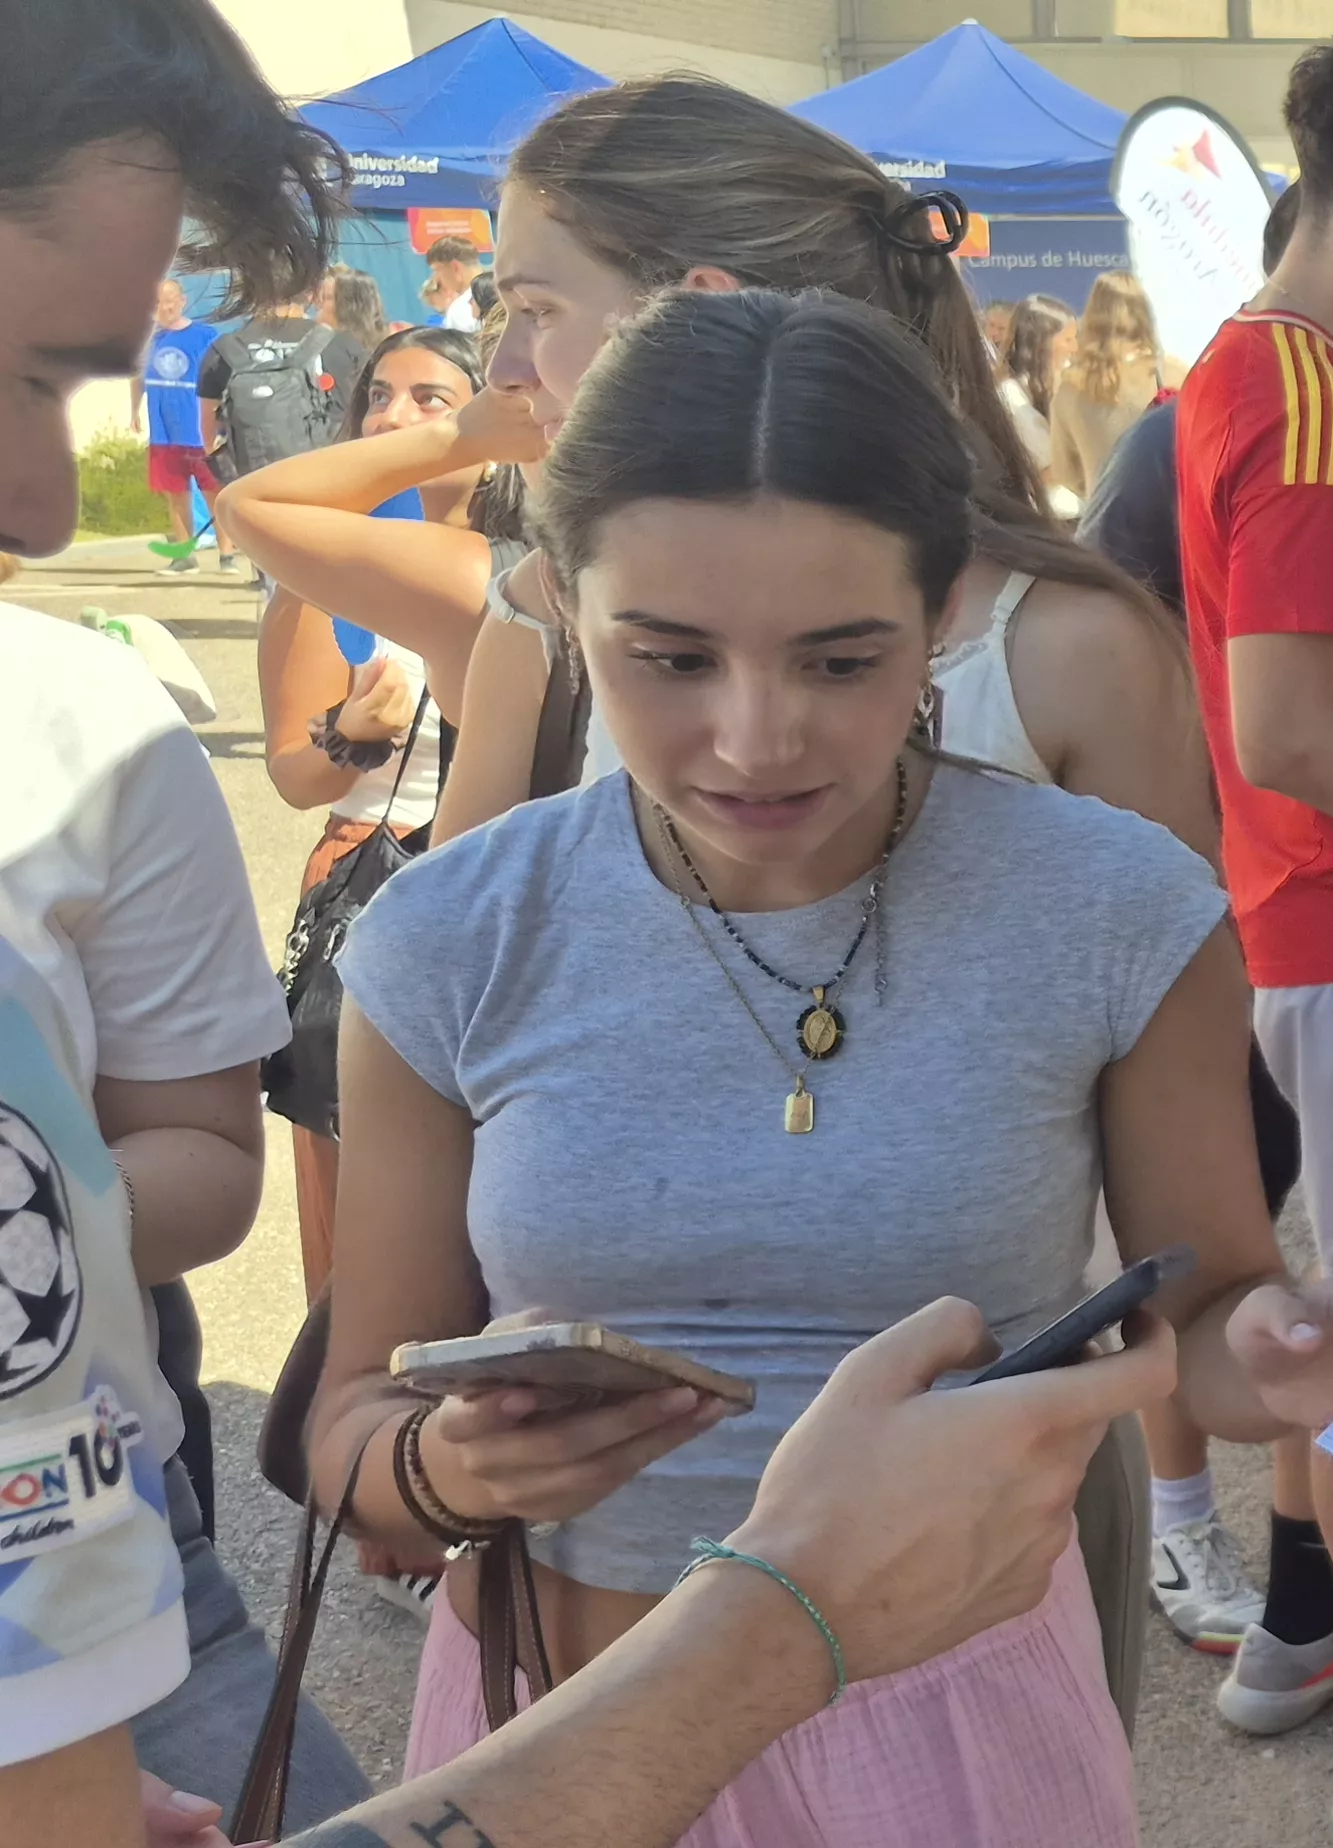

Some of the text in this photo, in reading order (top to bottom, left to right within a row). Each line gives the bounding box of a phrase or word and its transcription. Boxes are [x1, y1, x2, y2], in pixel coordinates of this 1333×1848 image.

[968, 249, 1130, 272] Campus de Huesca
[69, 1428, 124, 1499] 10
